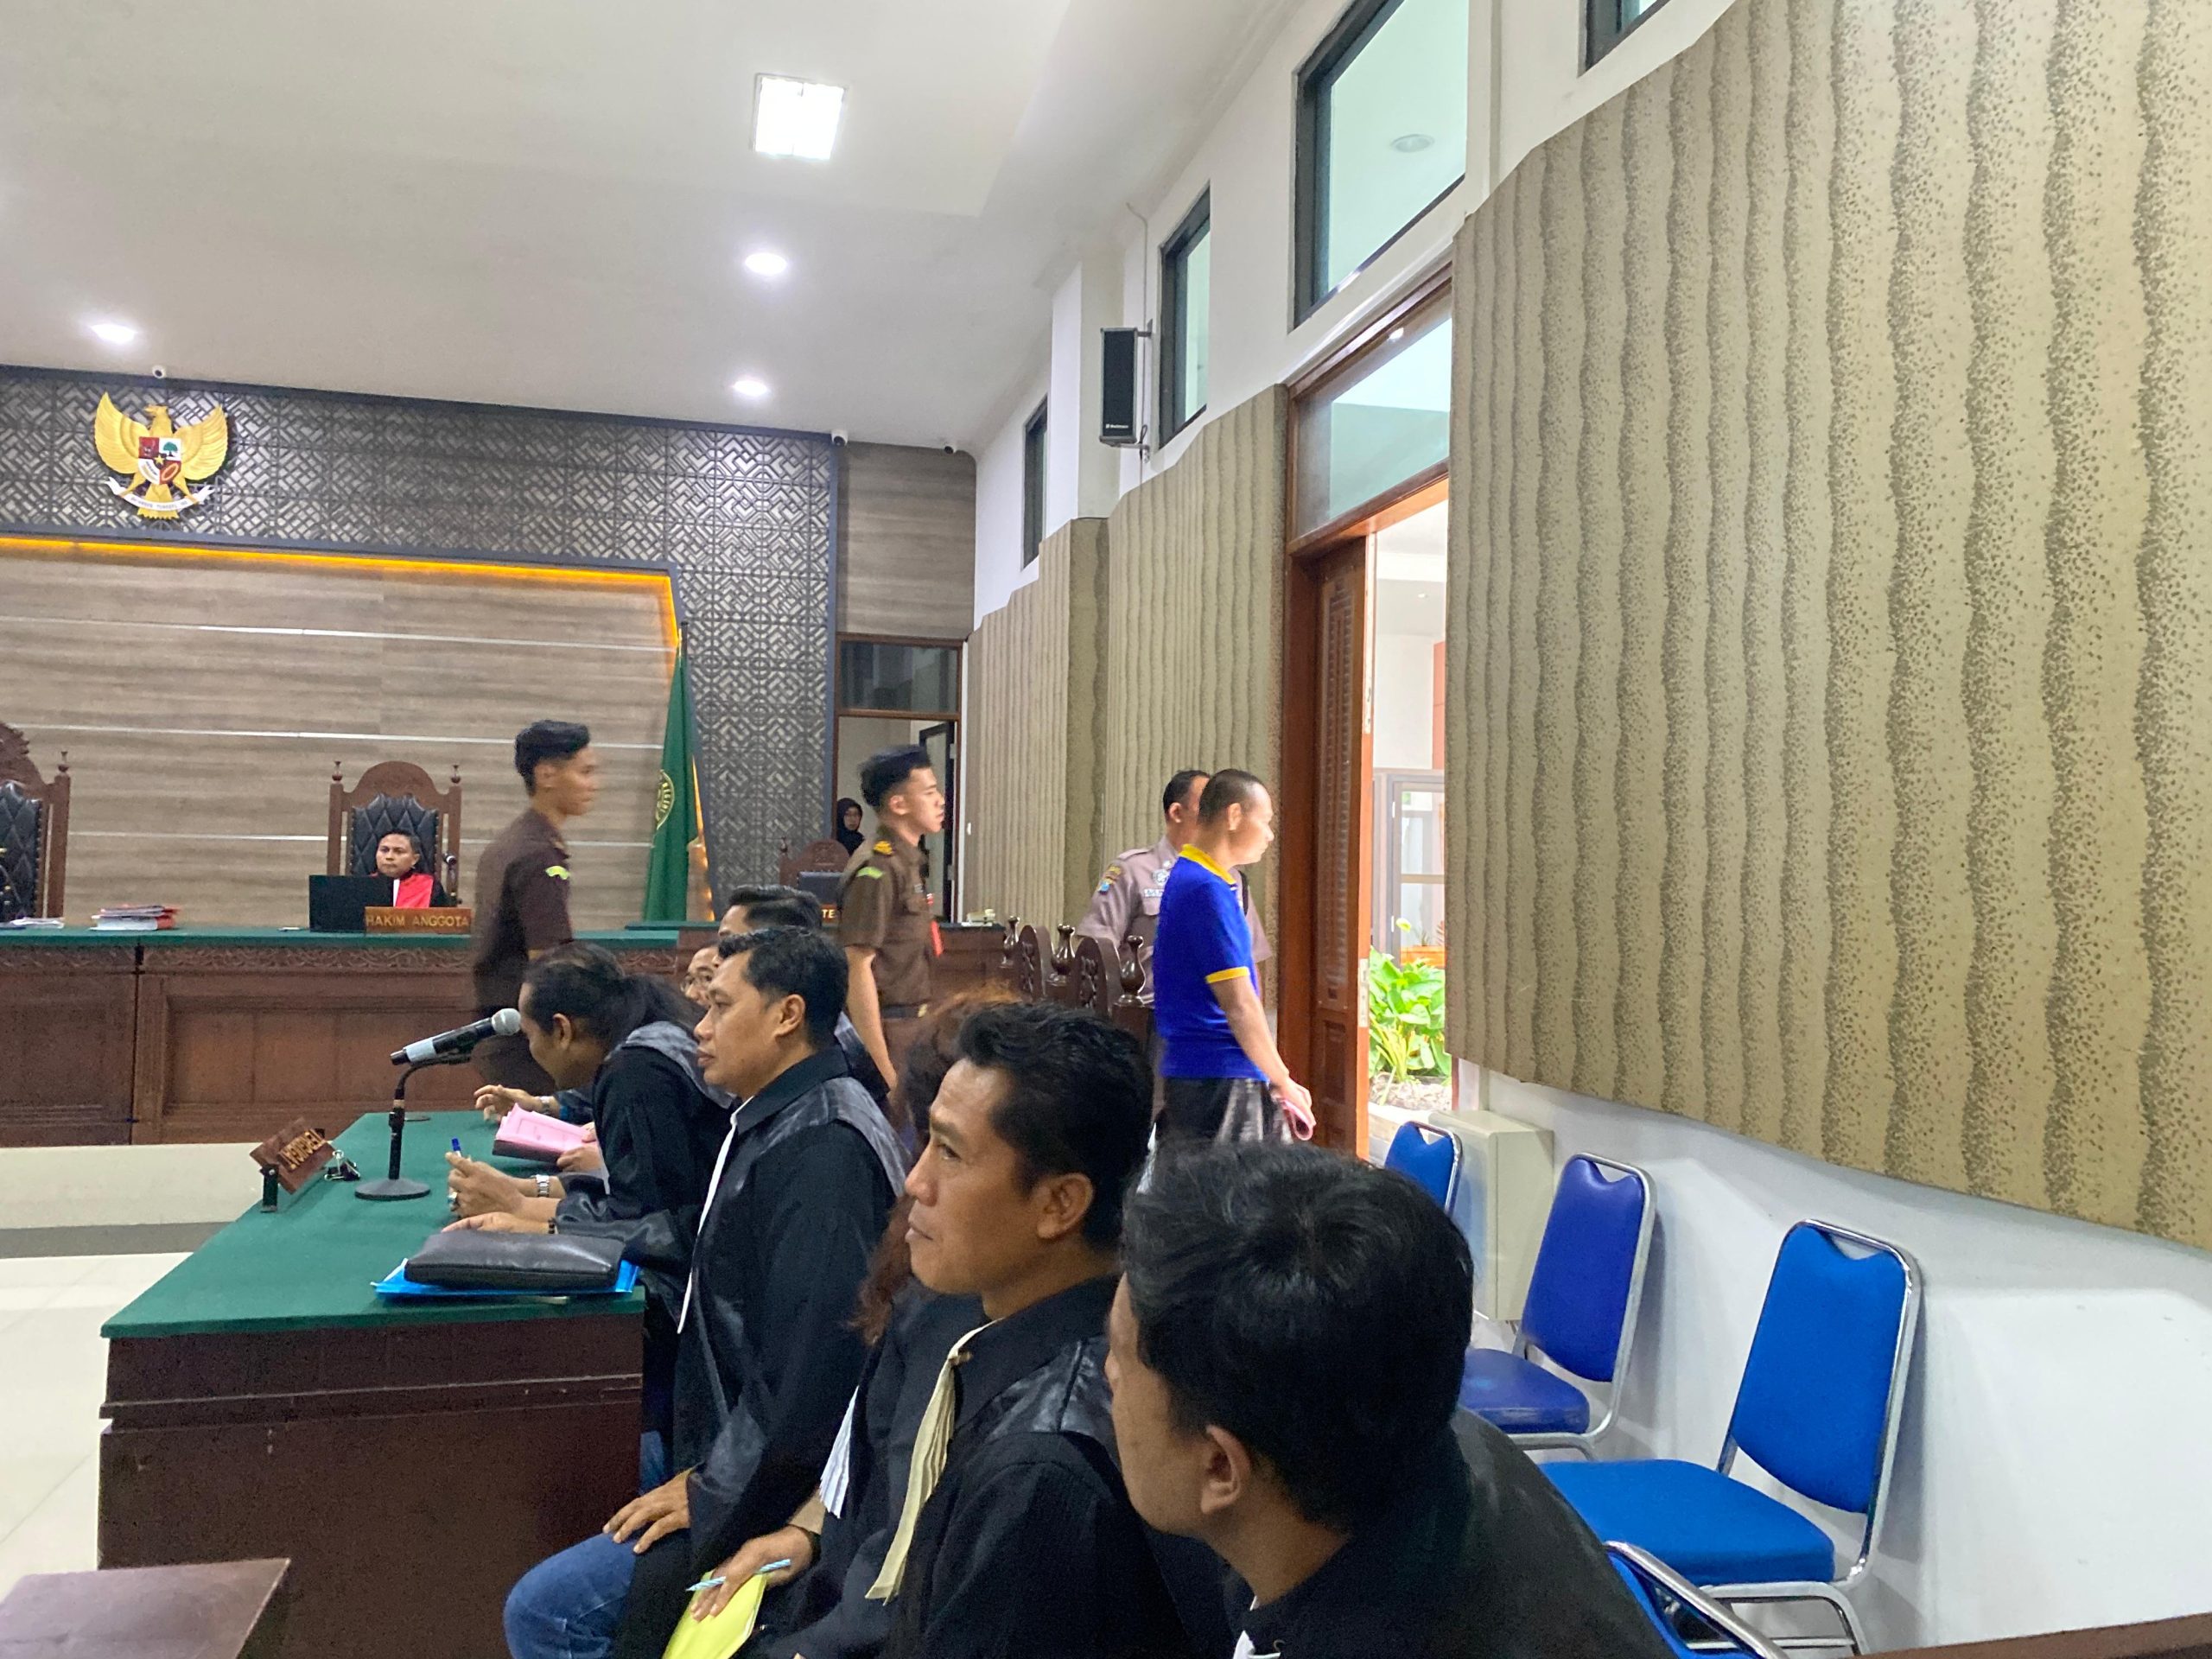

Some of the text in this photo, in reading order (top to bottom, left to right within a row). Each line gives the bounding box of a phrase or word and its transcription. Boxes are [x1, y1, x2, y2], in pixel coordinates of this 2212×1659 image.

[821, 909, 836, 918] TE
[366, 916, 468, 927] HAKIM ANGGOTA
